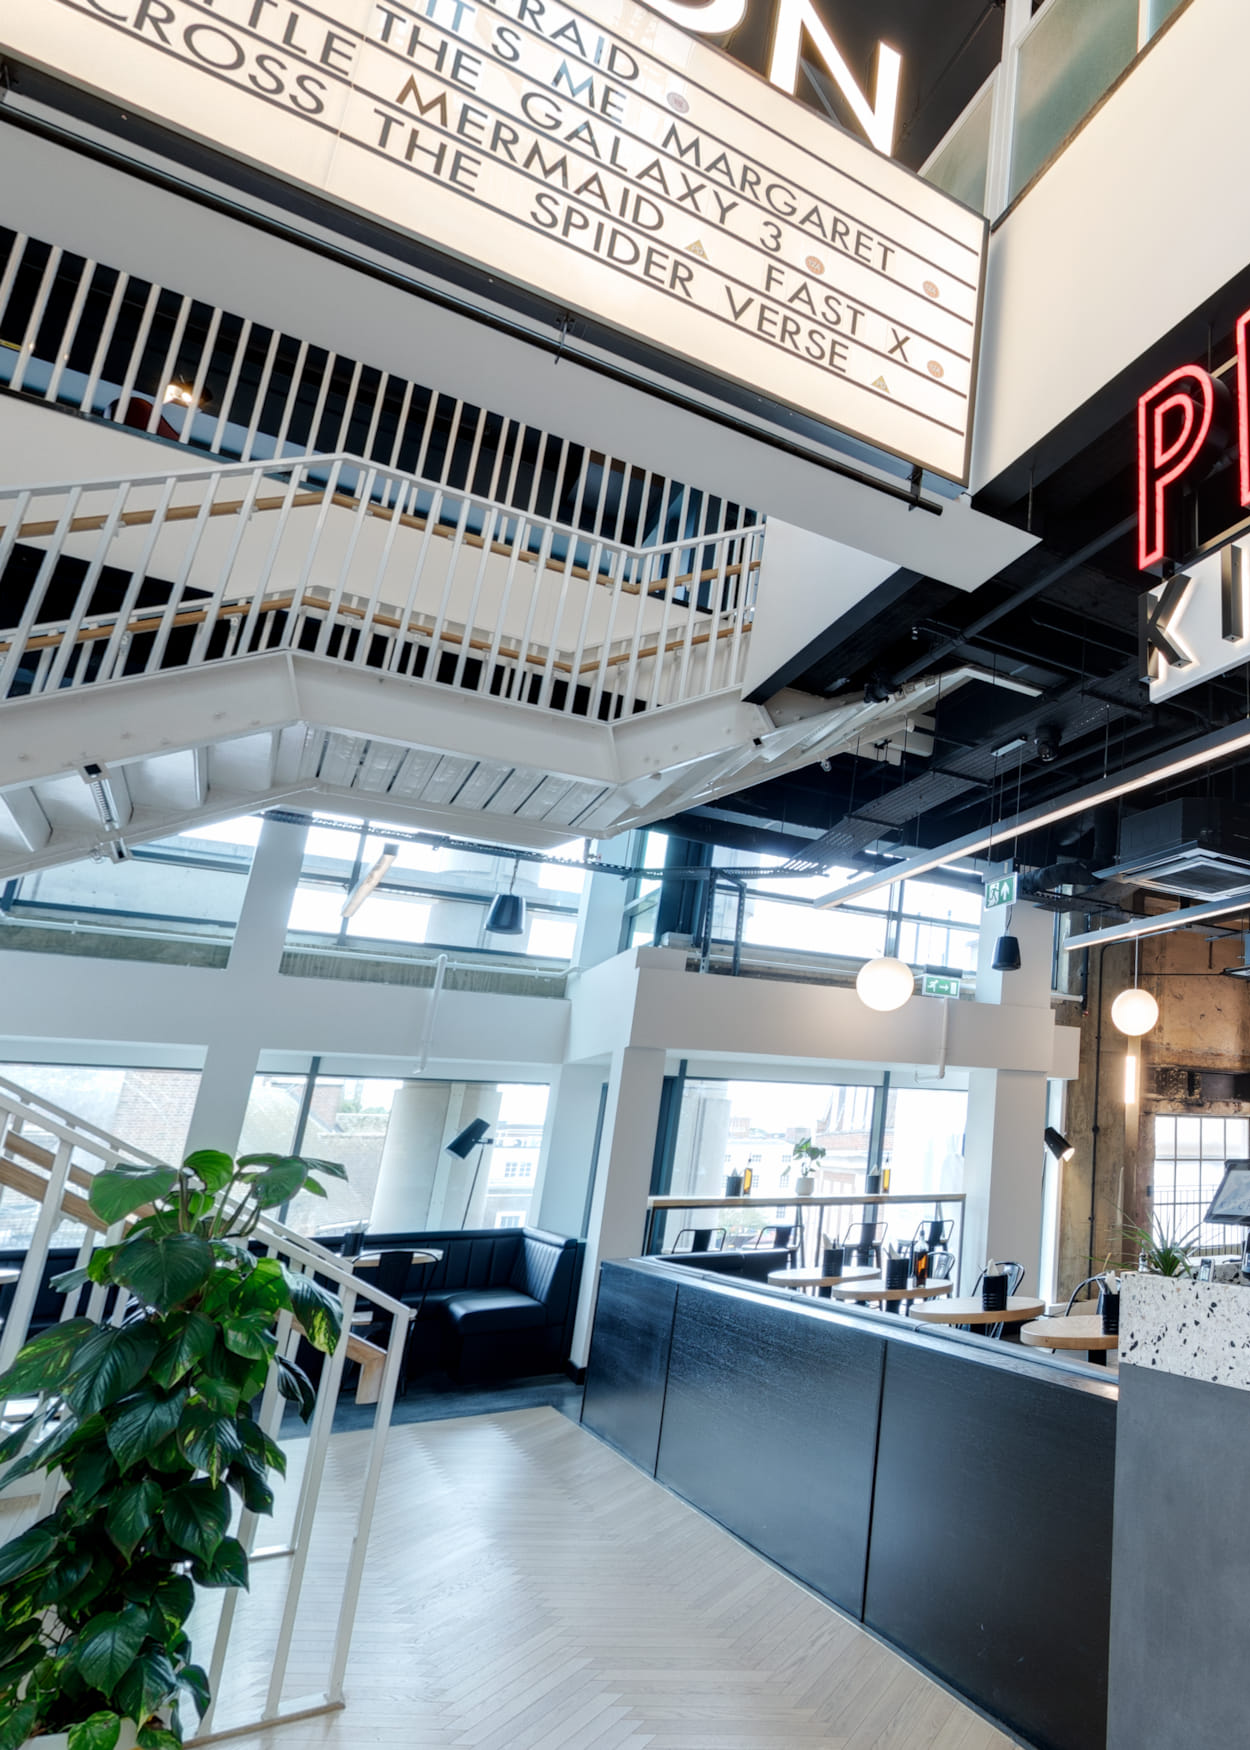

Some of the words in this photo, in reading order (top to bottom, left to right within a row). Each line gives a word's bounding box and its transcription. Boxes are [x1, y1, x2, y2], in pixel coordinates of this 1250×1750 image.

[376, 4, 482, 92] THE
[520, 91, 740, 226] GALAXY
[759, 220, 783, 253] 3
[489, 0, 640, 80] RAID
[491, 26, 521, 63] S
[552, 60, 626, 124] ME
[661, 122, 896, 272] MARGARET
[650, 0, 901, 158] N
[204, 0, 357, 76] TLE
[395, 73, 665, 232] MERMAID
[764, 263, 866, 337] FAST
[887, 327, 911, 364] X
[373, 107, 482, 193] THE
[529, 192, 694, 300] SPIDER
[724, 284, 849, 374] VERSE
